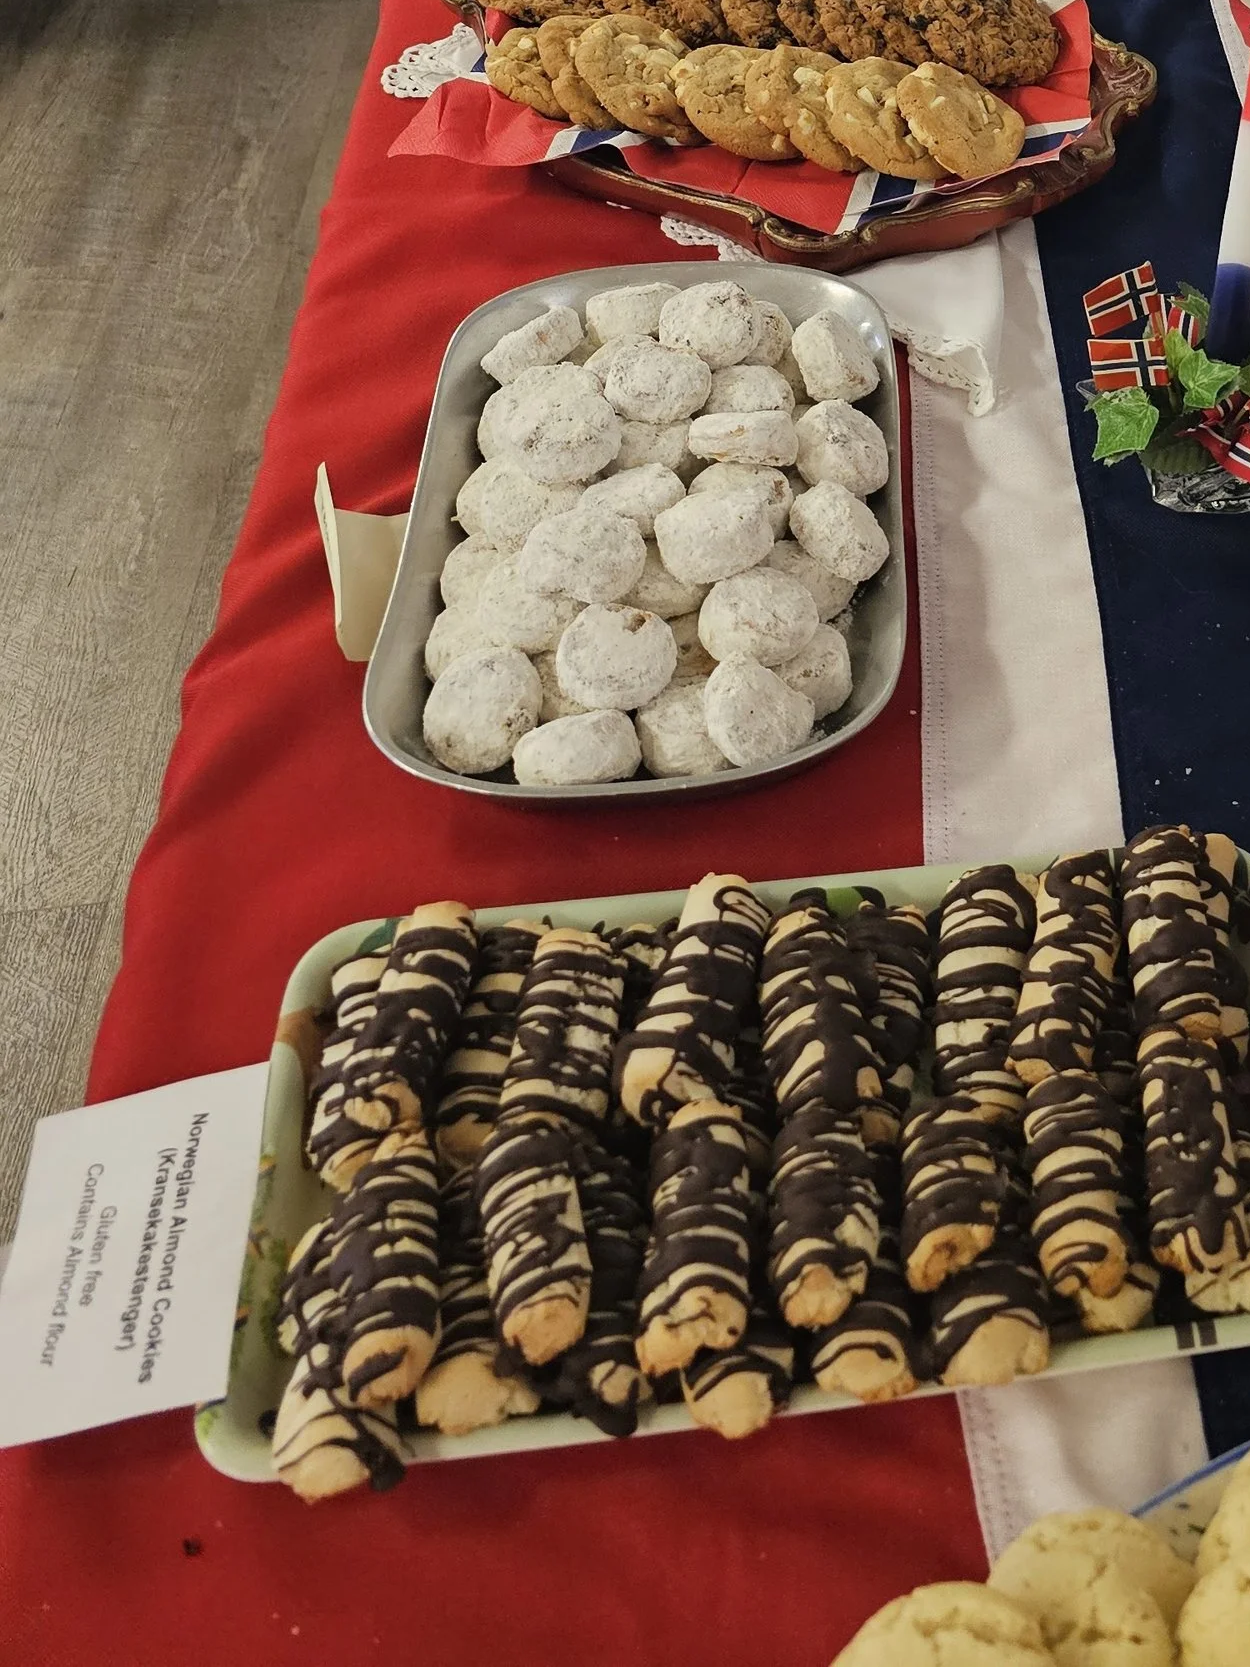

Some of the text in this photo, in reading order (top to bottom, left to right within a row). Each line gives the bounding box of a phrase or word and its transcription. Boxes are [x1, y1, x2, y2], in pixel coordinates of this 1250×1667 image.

[39, 1163, 105, 1368] Contains Almond flour
[78, 1205, 119, 1307] Gluten free
[114, 1146, 178, 1352] (Kransekakestenger)
[137, 1111, 210, 1384] Norwegian Almond Cookies
